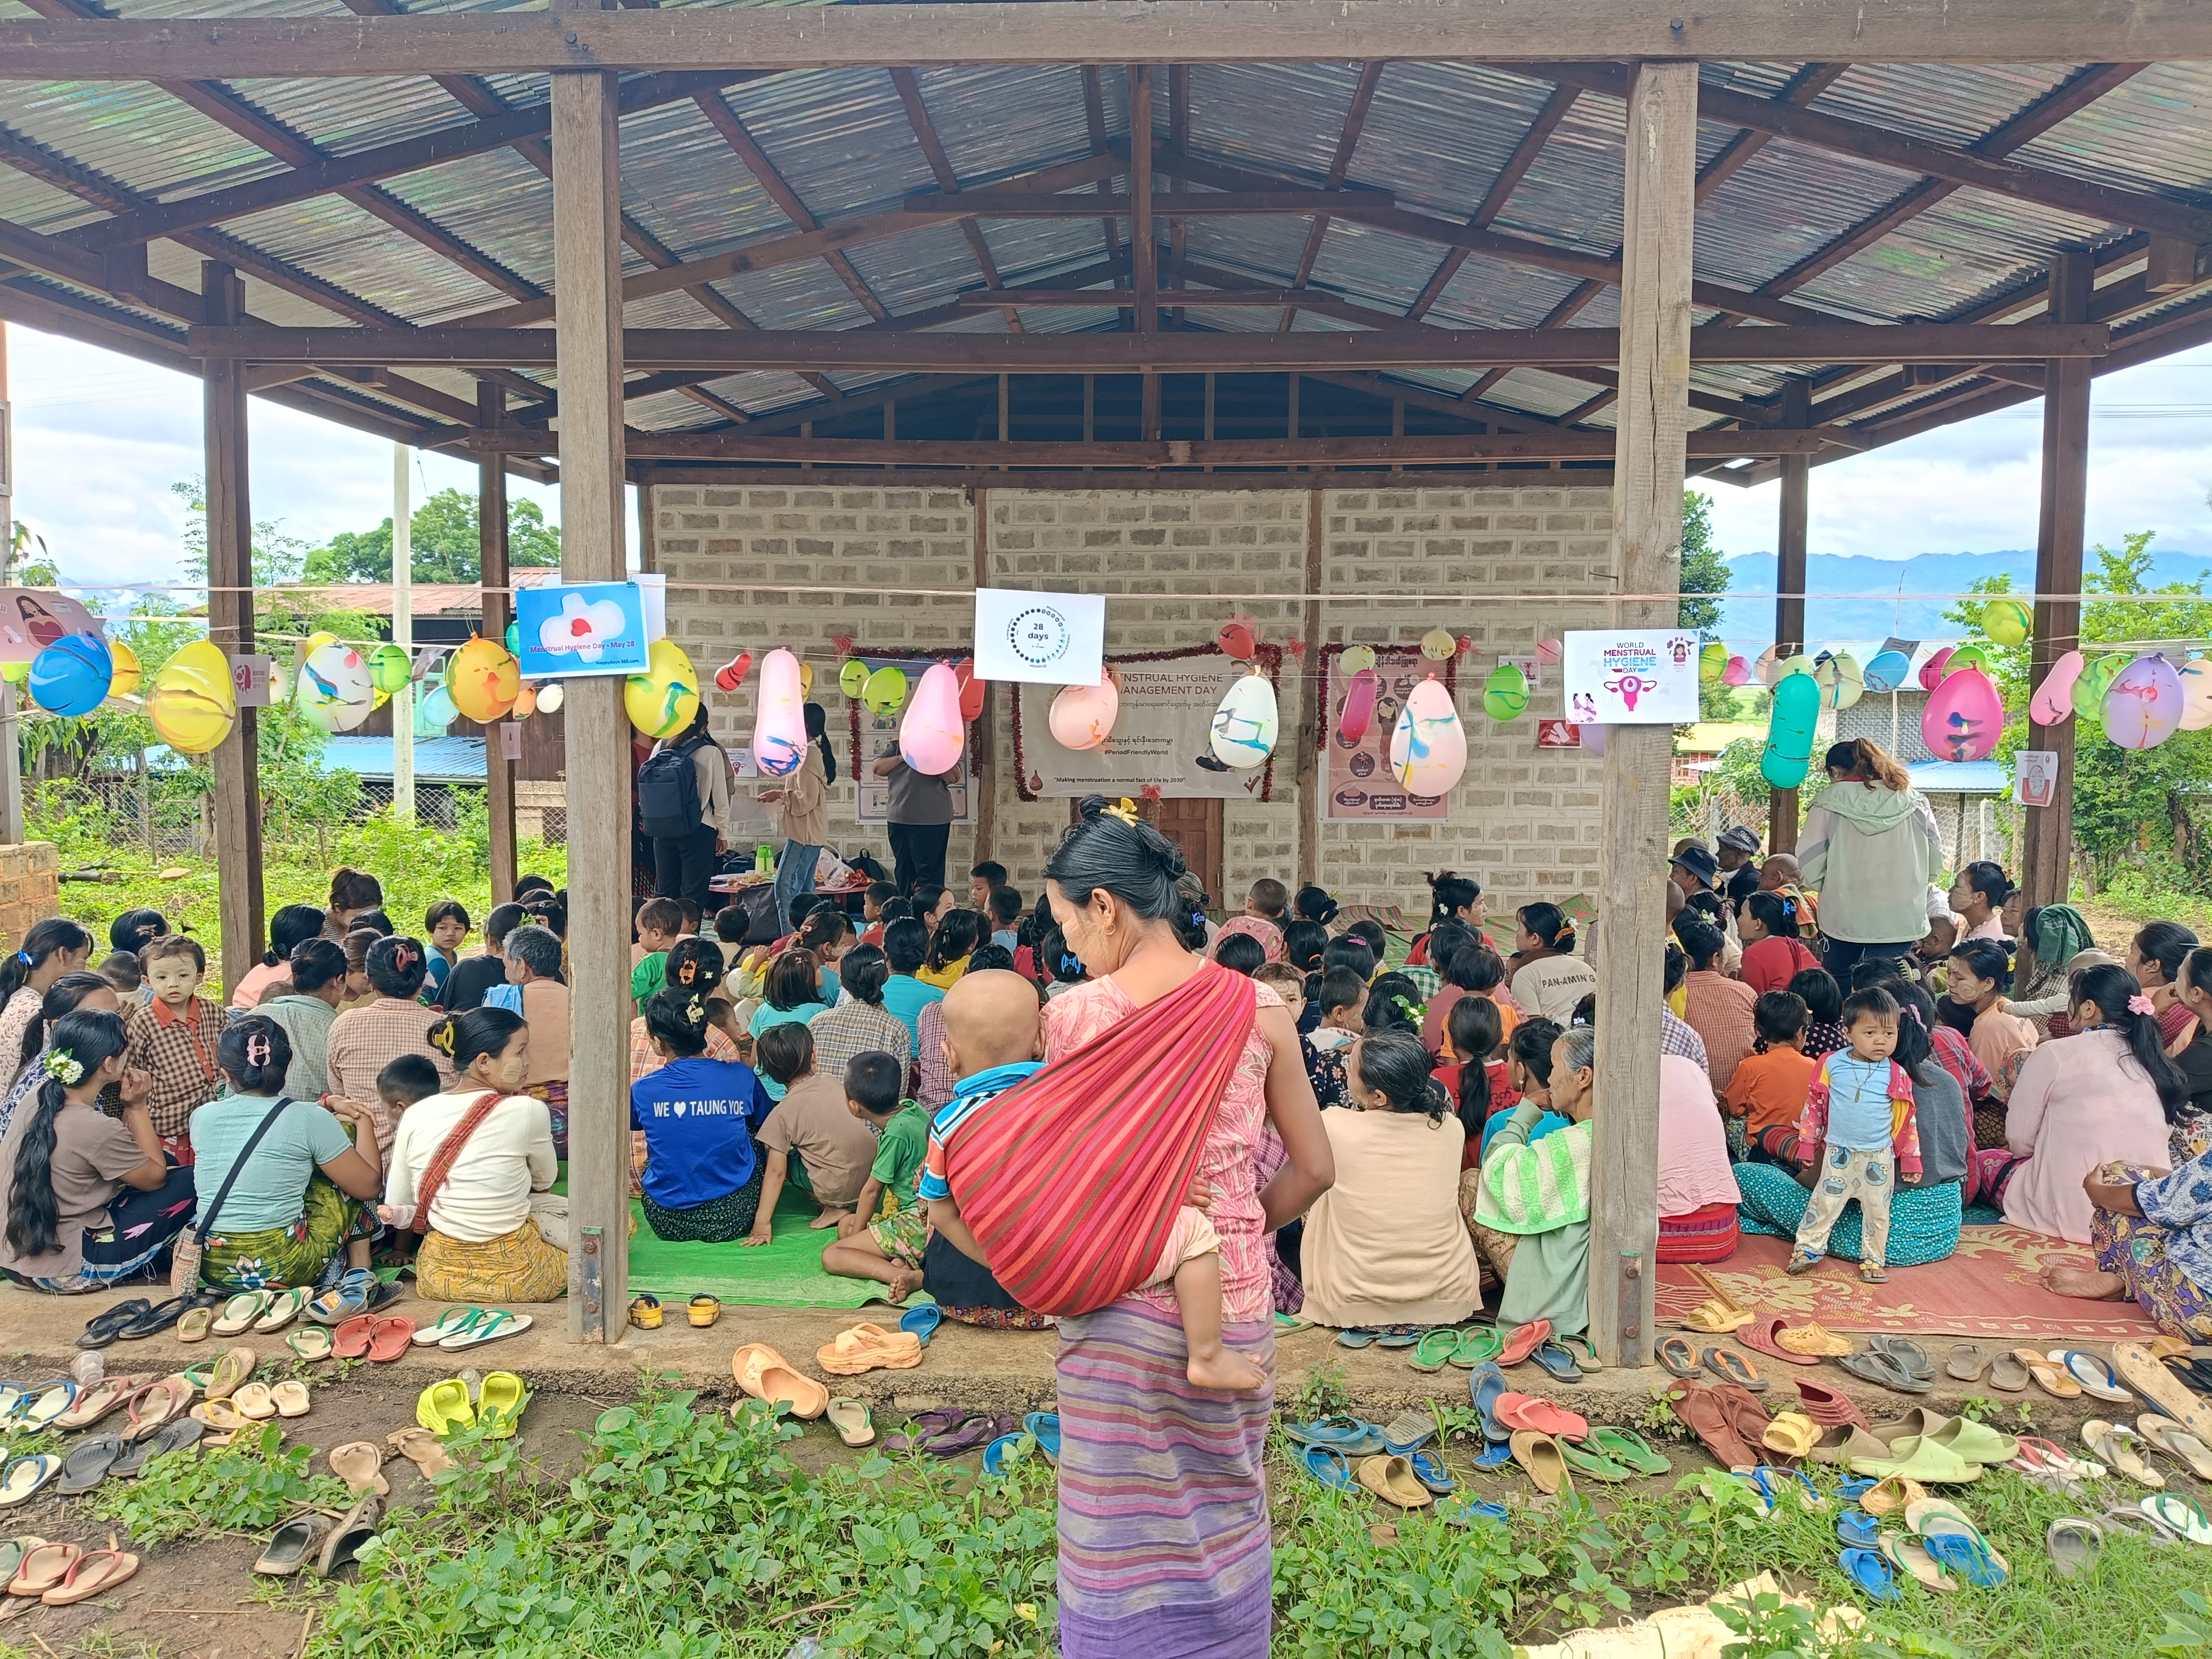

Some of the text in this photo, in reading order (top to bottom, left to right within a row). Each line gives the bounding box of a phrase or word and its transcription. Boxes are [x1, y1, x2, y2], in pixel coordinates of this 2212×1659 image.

[1028, 632, 1049, 642] days
[530, 645, 563, 653] Menstrual
[565, 644, 591, 652] Hygiene
[1604, 649, 1657, 657] MENSTRUAL
[1604, 657, 1657, 667] HYGIENE
[1121, 673, 1174, 682] NSTRUAL
[1176, 673, 1223, 682] HYGIENE
[1195, 686, 1217, 694] DAY
[1542, 973, 1596, 989] PAN-AMIN'G
[653, 1099, 745, 1117] WE TAUNG YOE
